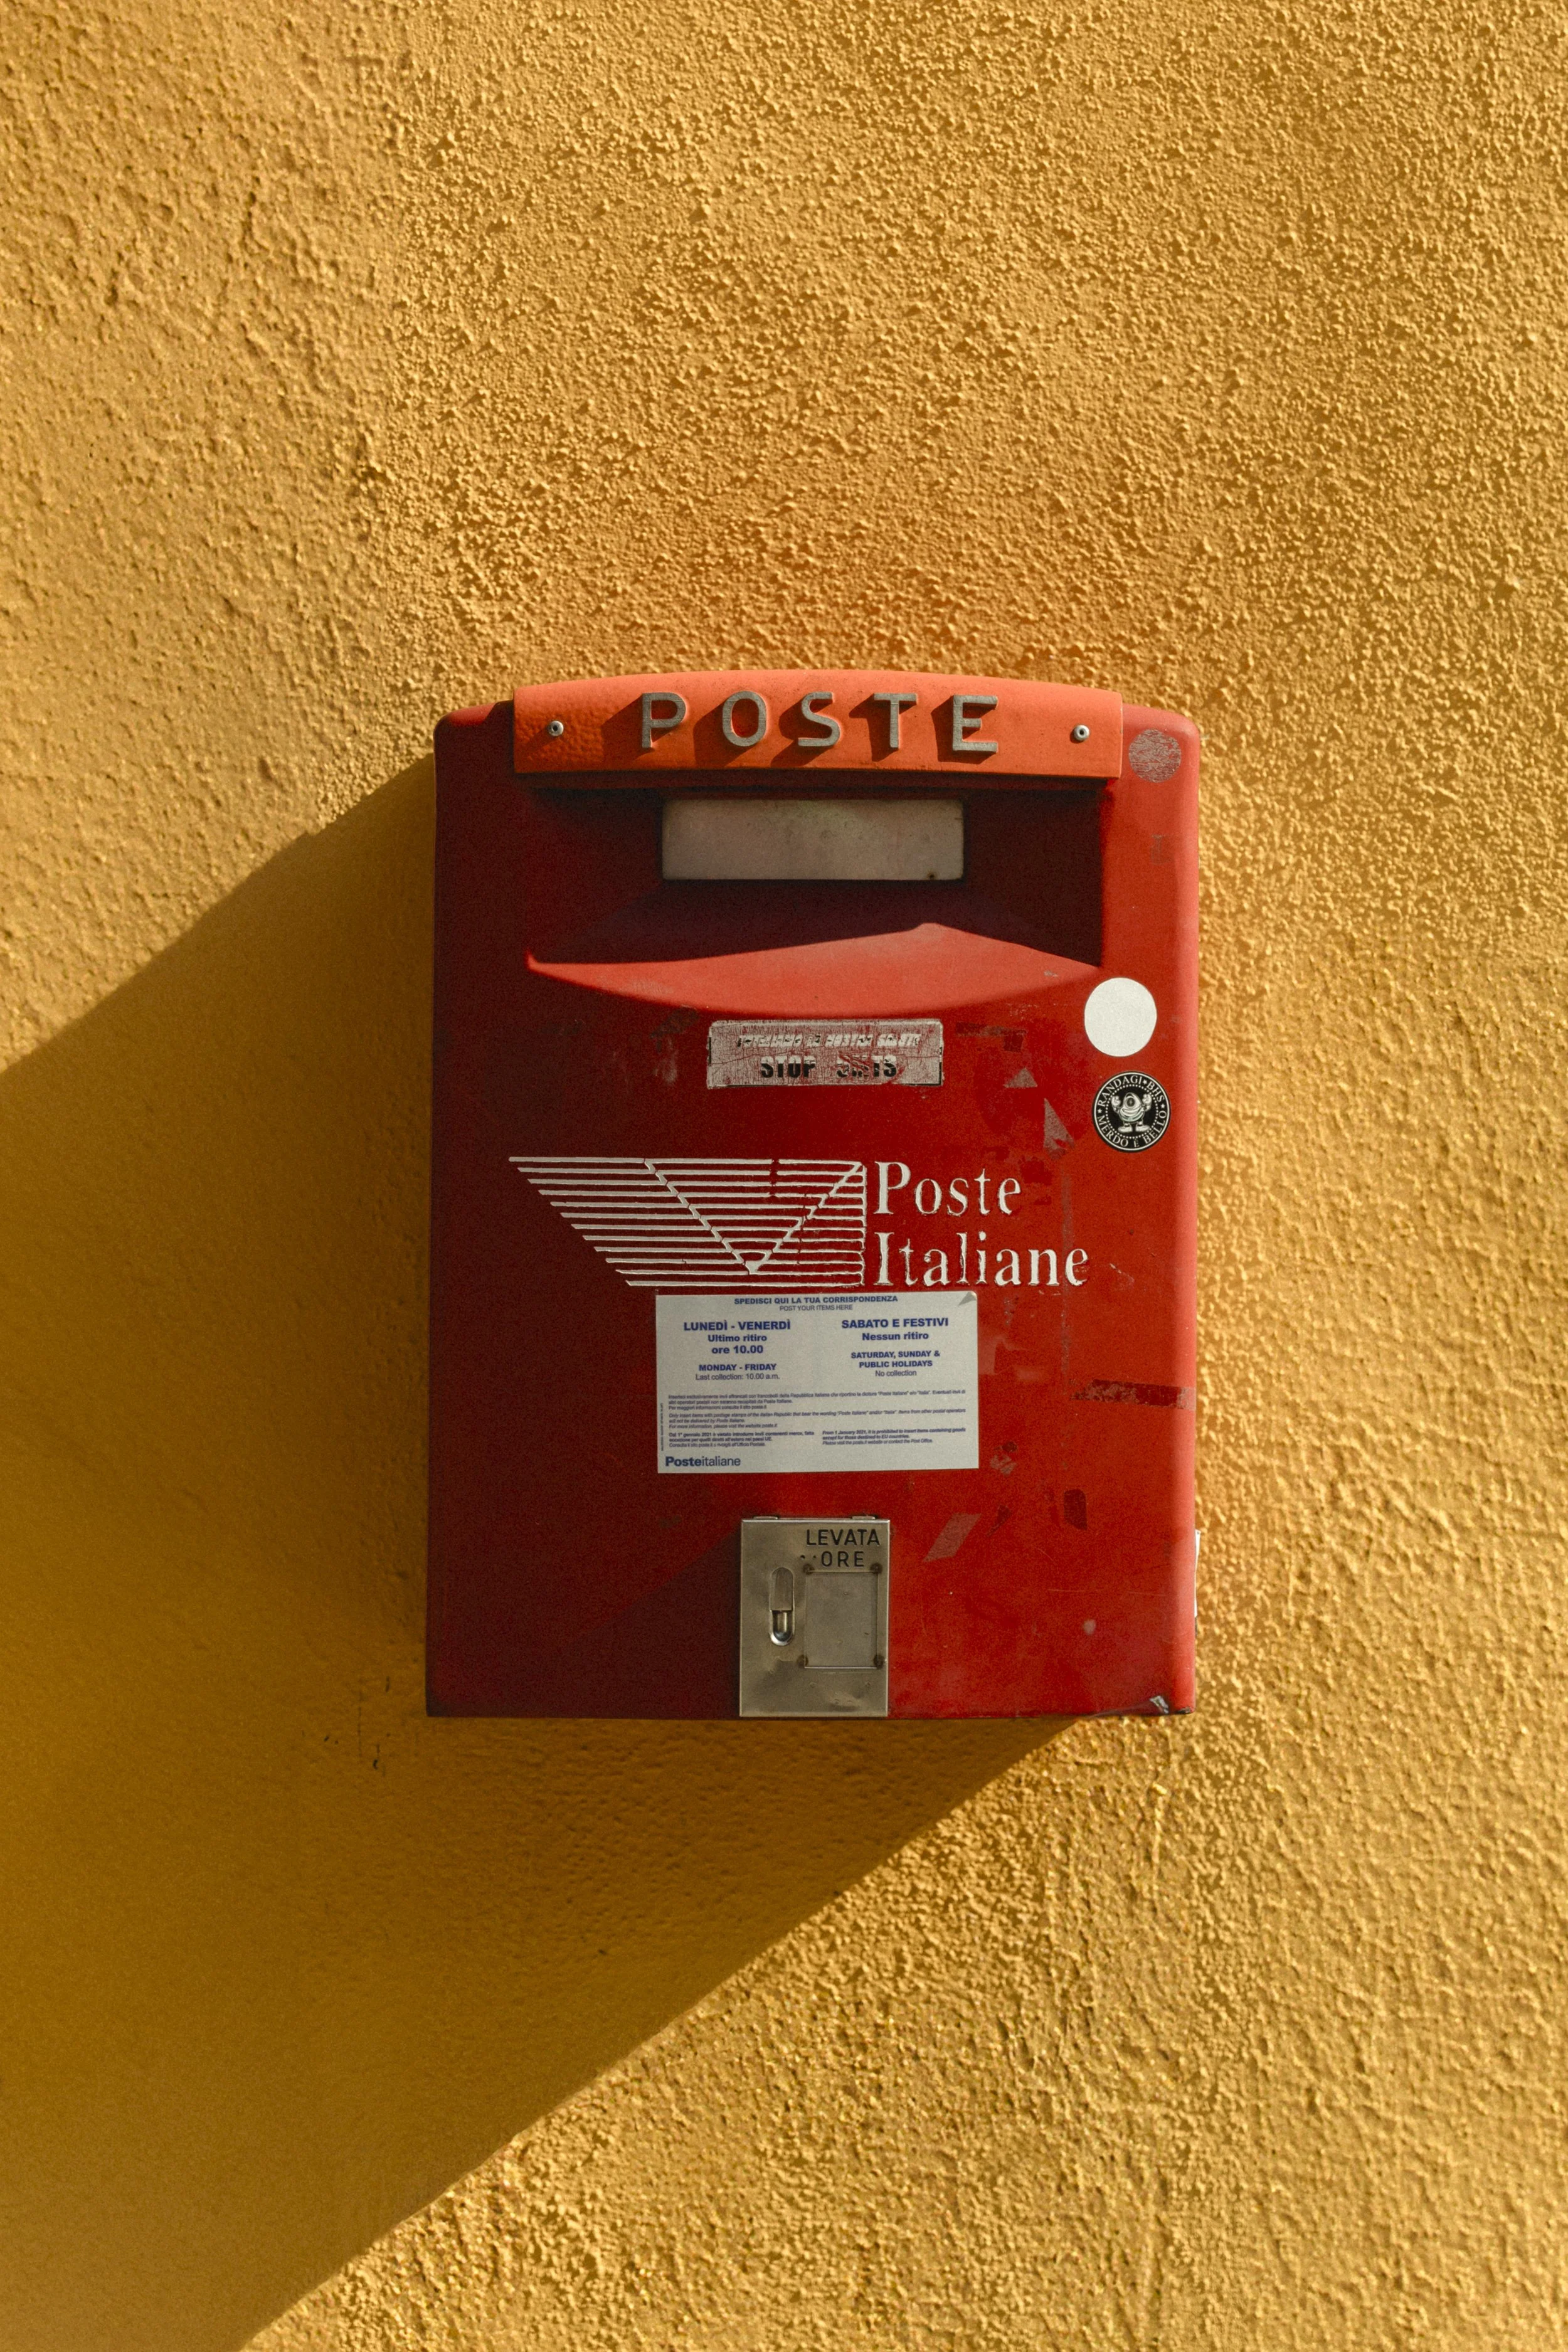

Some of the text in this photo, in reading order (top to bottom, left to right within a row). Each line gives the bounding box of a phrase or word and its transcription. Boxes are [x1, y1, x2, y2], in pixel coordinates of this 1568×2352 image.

[640, 692, 1000, 753] POSTE
[761, 1056, 816, 1078] STOP
[1098, 1075, 1142, 1108] RANDAGI
[1146, 1080, 1165, 1103] BHS
[1097, 1115, 1128, 1147] MERDO
[1143, 1111, 1167, 1144] BELLO
[874, 1161, 1022, 1216] Poste
[875, 1231, 1090, 1286] Italiane
[684, 1320, 728, 1331] LUNEDÌ
[738, 1319, 790, 1330] VENERDÌ
[842, 1318, 948, 1328] SABATO E FESTIVI
[708, 1334, 740, 1342] Ultimo
[862, 1332, 928, 1340] Nessun ritiro
[733, 1345, 763, 1353] 10.00
[851, 1351, 896, 1359] SATURDAY,
[665, 1456, 741, 1466] Posteitaliane
[806, 1529, 881, 1547] LEVATA
[821, 1551, 865, 1567] ORE
